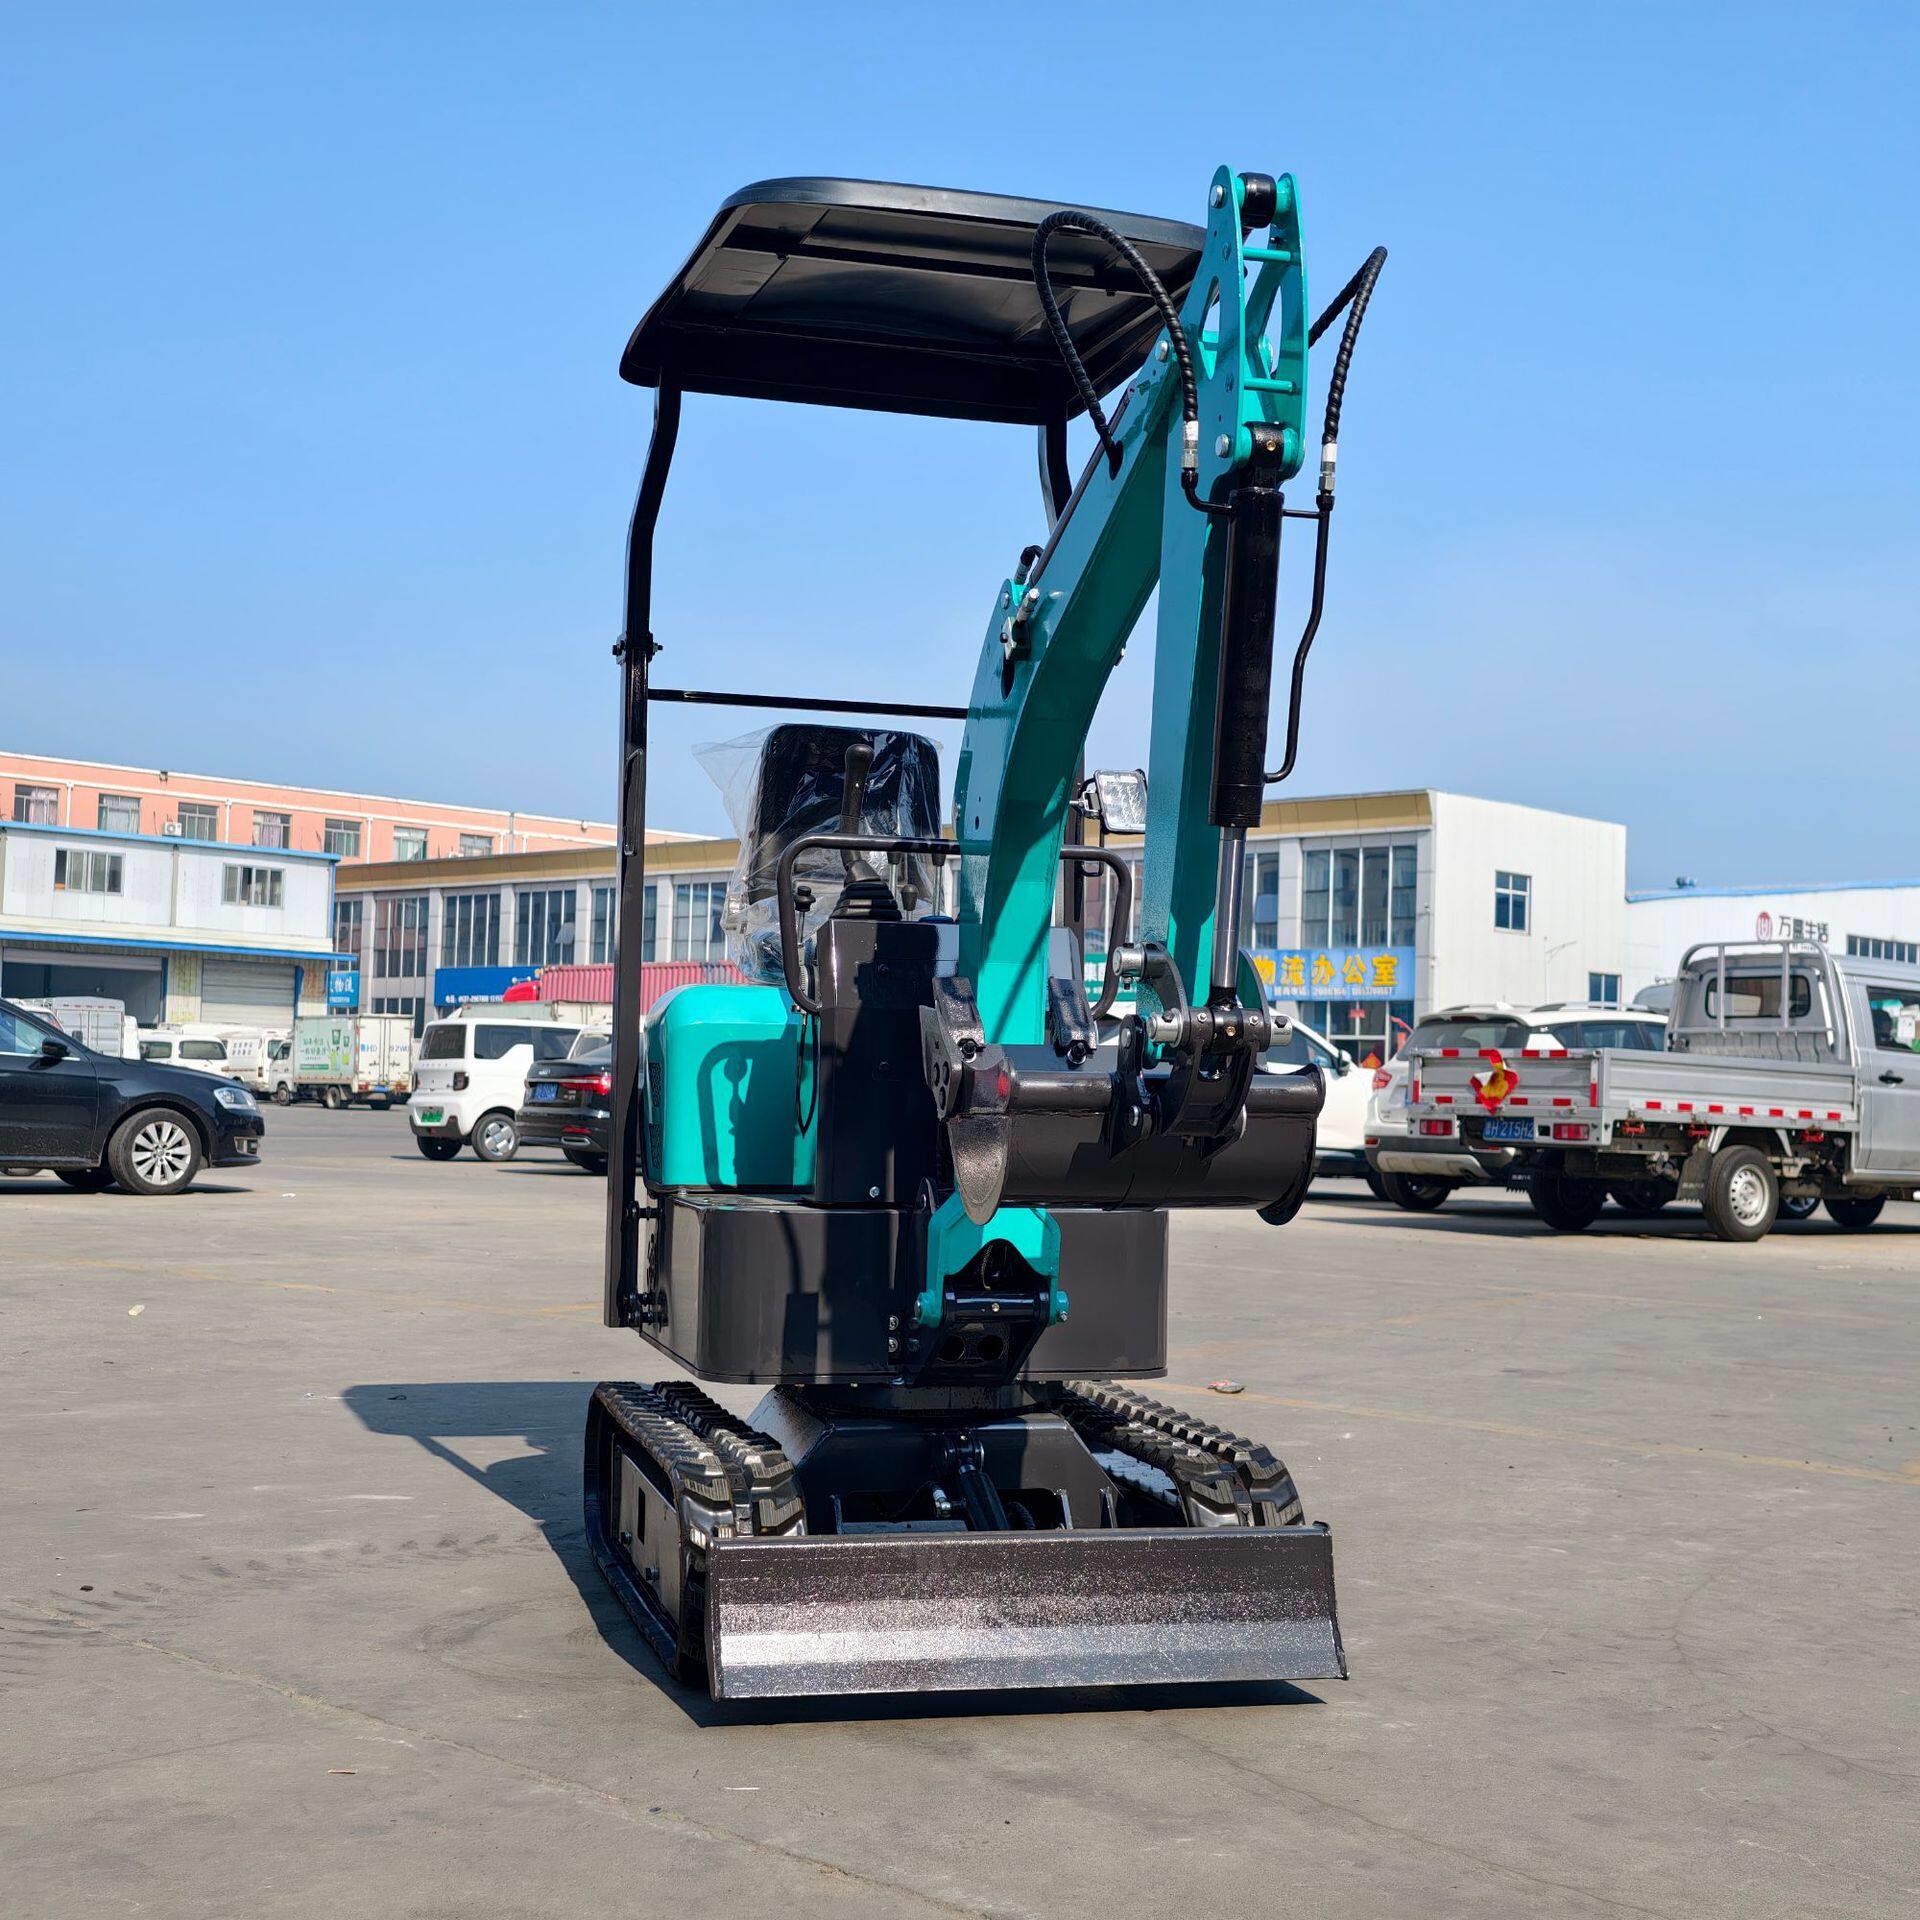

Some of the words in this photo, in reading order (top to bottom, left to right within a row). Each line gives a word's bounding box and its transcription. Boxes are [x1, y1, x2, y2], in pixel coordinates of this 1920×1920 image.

[1253, 953, 1398, 987] 物流办公室
